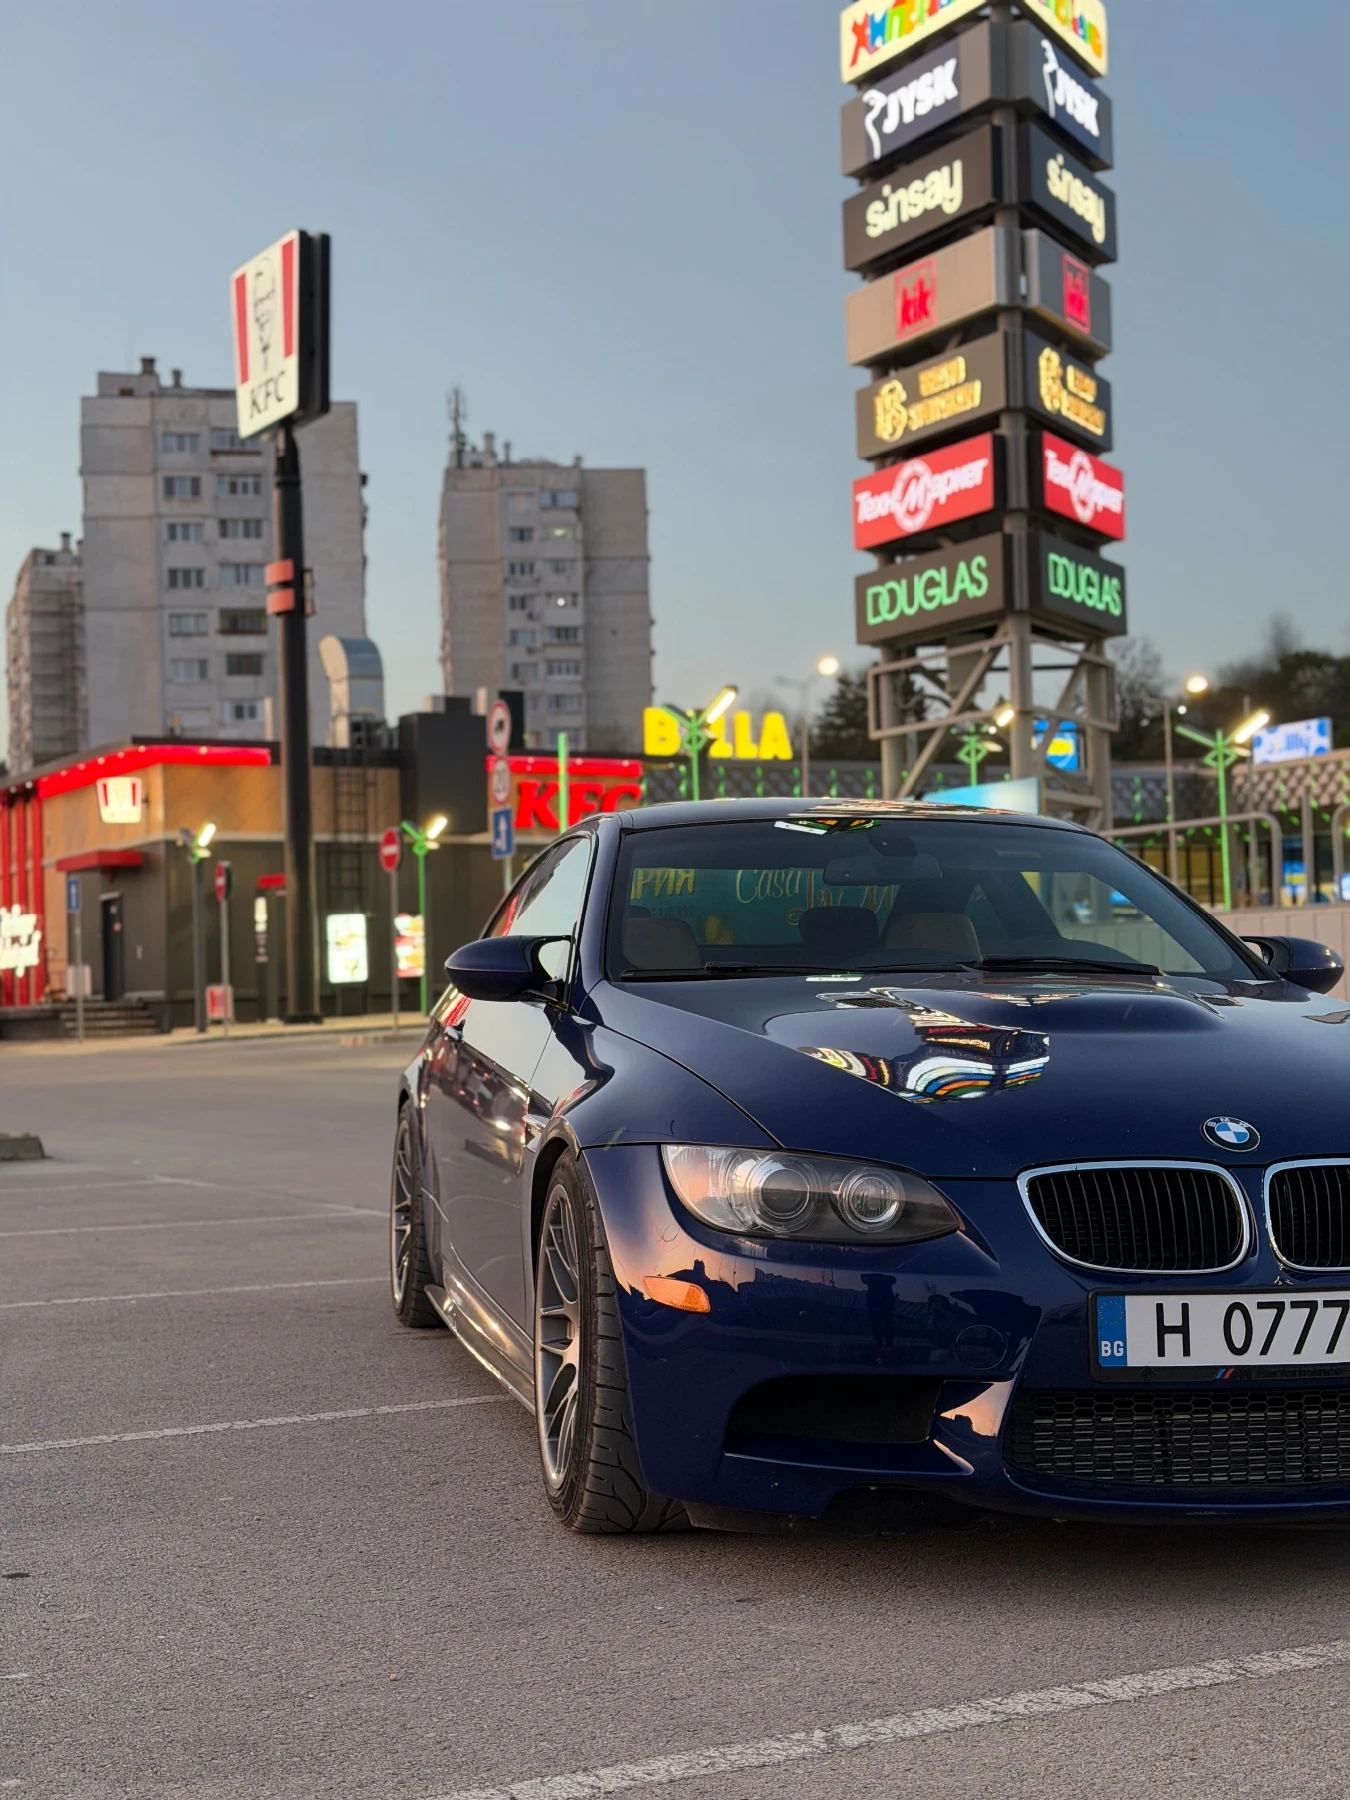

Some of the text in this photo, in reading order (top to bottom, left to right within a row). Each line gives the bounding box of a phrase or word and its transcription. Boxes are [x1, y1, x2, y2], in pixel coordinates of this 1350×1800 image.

[882, 58, 958, 134] JYSK
[866, 159, 963, 238] sinsay
[249, 370, 286, 420] KFC
[866, 555, 989, 626] DOUGLAS
[1048, 553, 1122, 617] DOUGLAS
[643, 707, 793, 760] BLLA
[514, 780, 642, 829] KFC
[1206, 1116, 1251, 1128] BMW
[1101, 1340, 1124, 1357] BG
[1155, 1299, 1350, 1358] H 0777
